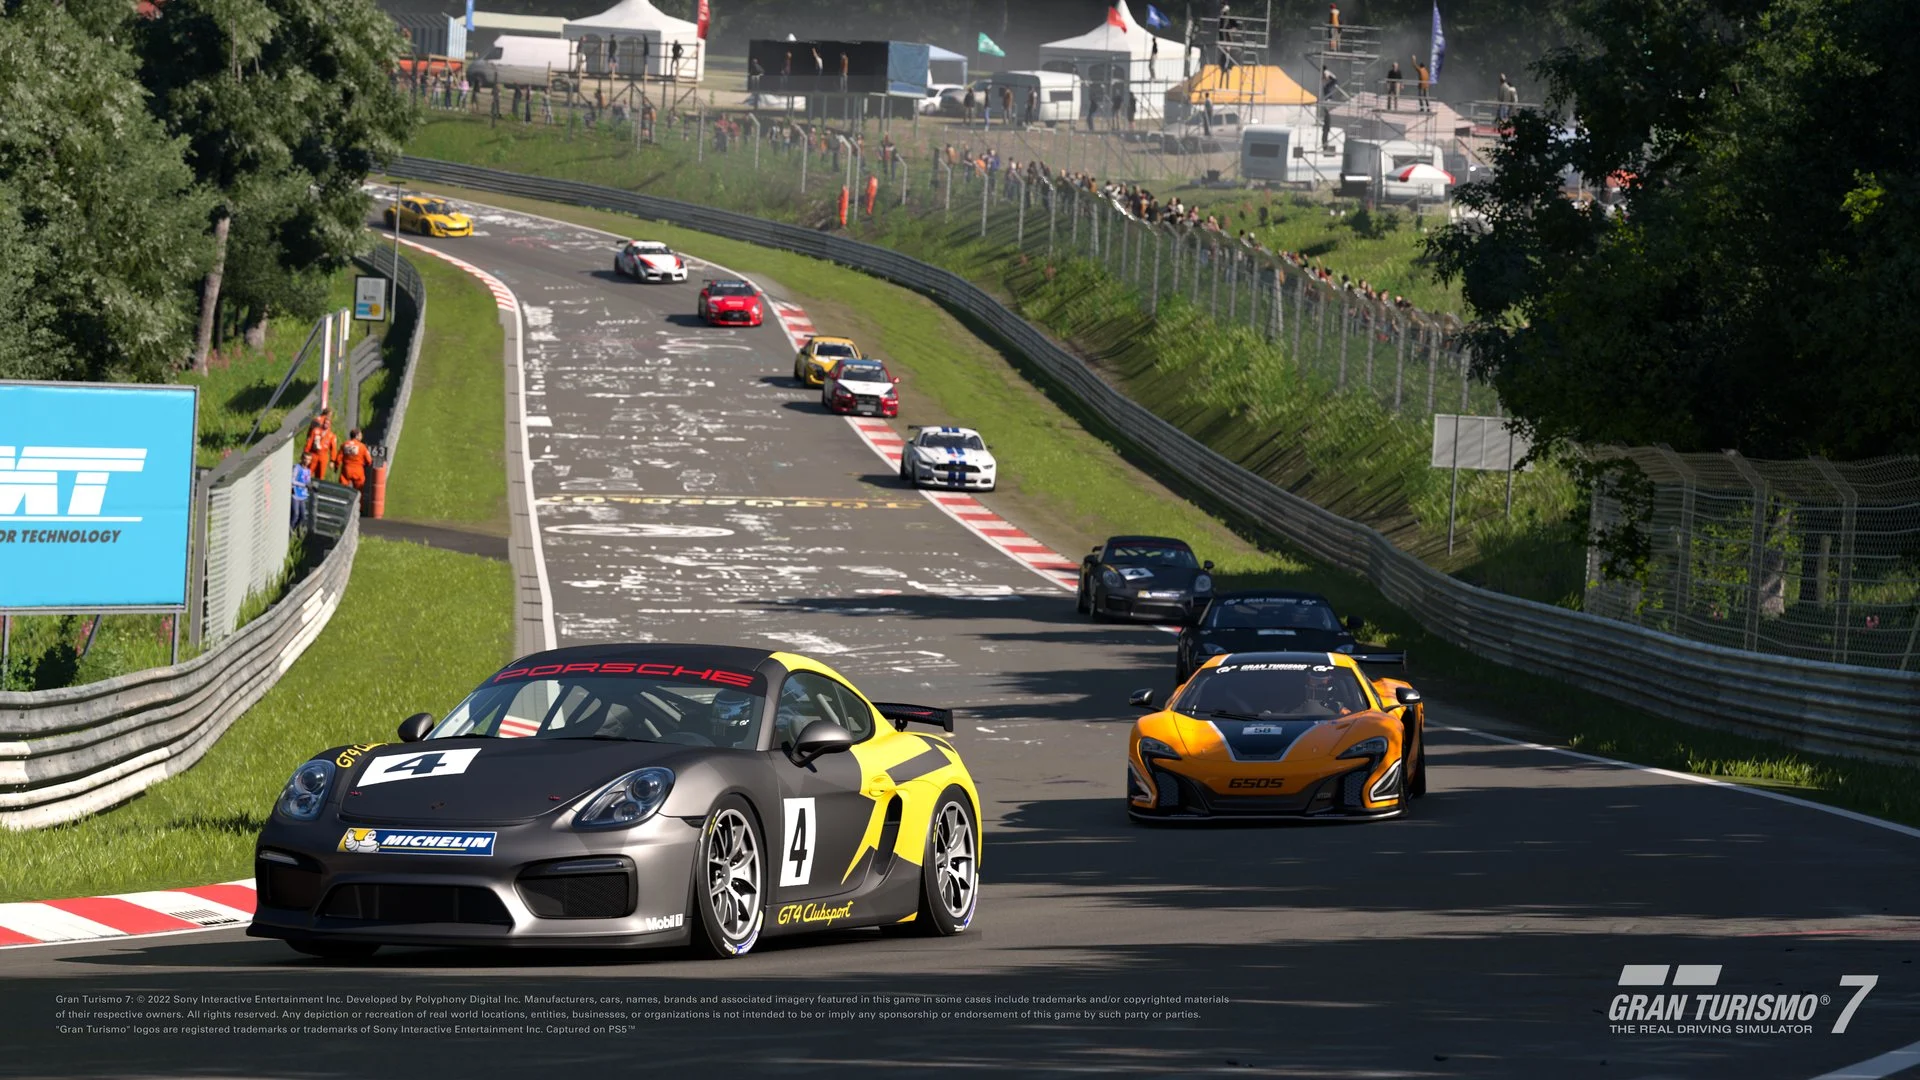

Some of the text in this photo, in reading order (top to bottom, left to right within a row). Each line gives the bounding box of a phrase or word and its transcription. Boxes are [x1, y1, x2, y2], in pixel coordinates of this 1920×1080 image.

[21, 530, 122, 543] TECHNOLOGY
[493, 663, 754, 688] PORSCHE
[383, 752, 447, 775] 4
[382, 835, 492, 848] MICHELIN
[789, 807, 808, 878] 4
[645, 914, 674, 930] Mobil
[778, 900, 854, 926] GT4 Clubsport
